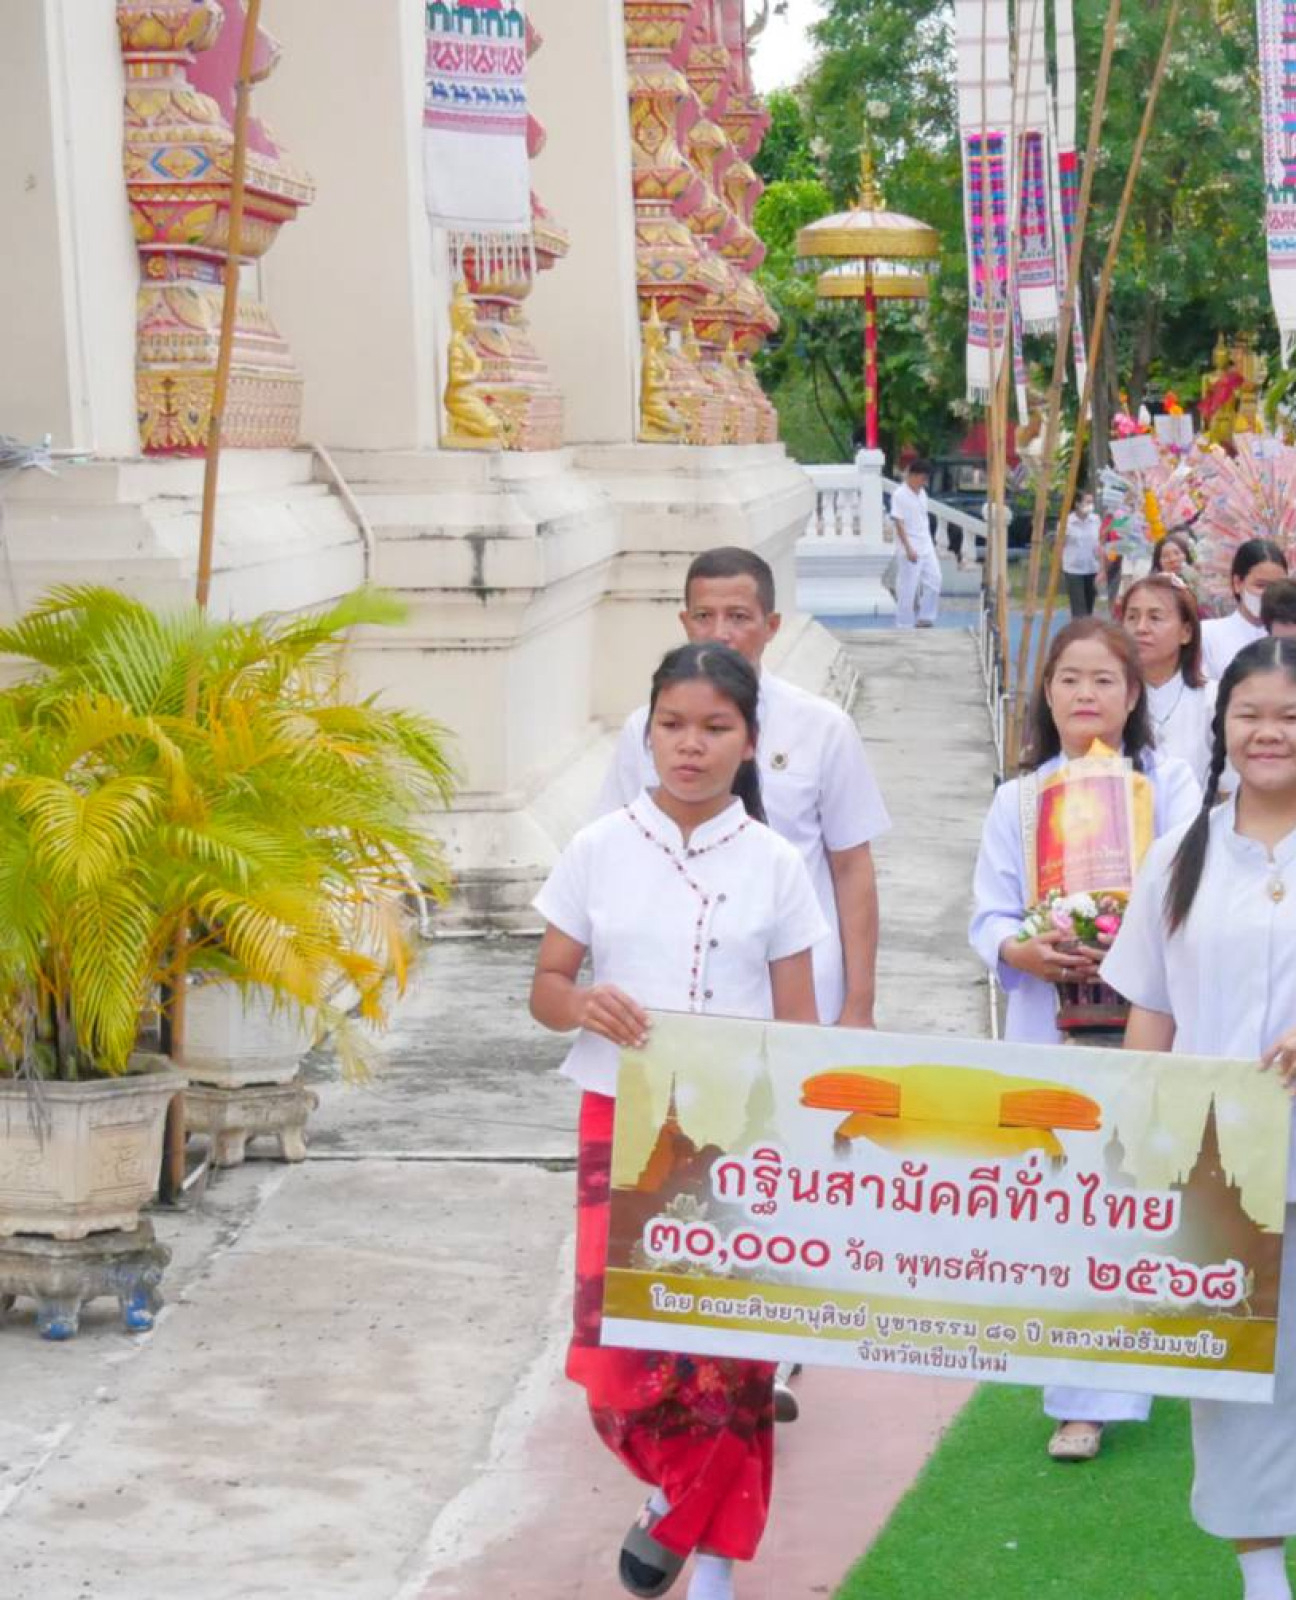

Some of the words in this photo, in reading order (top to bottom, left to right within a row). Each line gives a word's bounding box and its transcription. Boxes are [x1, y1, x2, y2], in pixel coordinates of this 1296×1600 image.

[716, 1147, 1175, 1232] กฐินสามัคคีทั่วไทย
[649, 1223, 831, 1268] ๓๐,๐๐๐
[845, 1236, 884, 1272] วัด
[895, 1248, 1071, 1289] พุทธศักราช
[1086, 1255, 1238, 1301] ๒๕๖๘
[653, 1285, 692, 1311] โดย
[700, 1296, 867, 1331] คณะศิษยานุศิษย์
[876, 1314, 977, 1338] บูชาธรรม
[985, 1323, 1017, 1341] ๘๑
[1026, 1321, 1041, 1343] ปี
[1050, 1328, 1225, 1356] หลวงพ่อธัมมชโย
[857, 1339, 1008, 1372] จังหวัดเชียงใหม่
